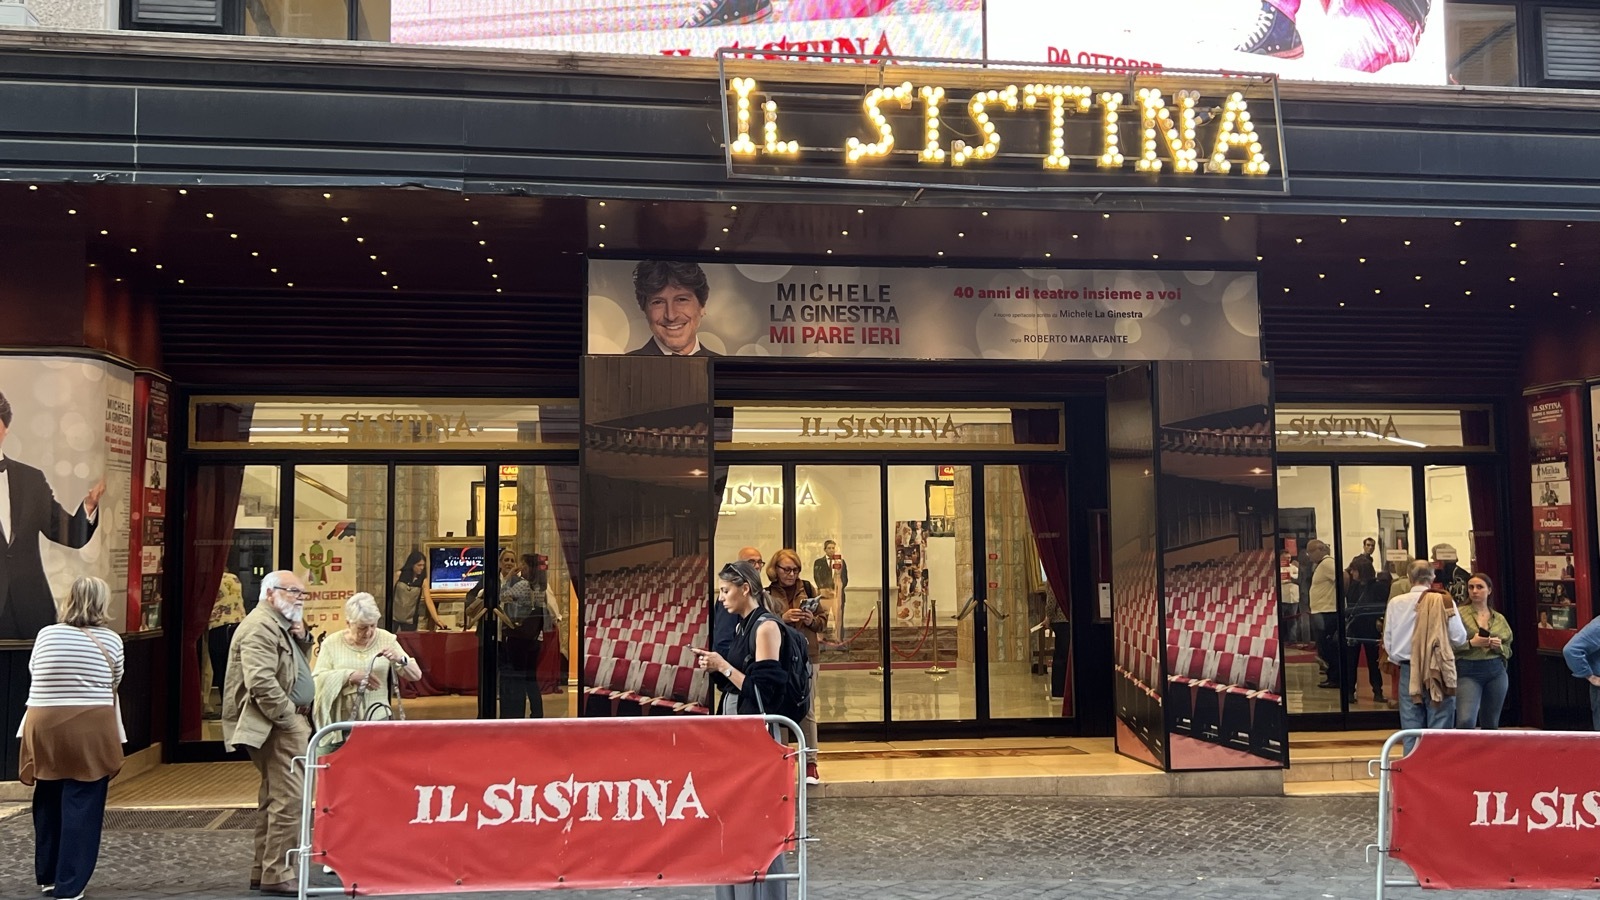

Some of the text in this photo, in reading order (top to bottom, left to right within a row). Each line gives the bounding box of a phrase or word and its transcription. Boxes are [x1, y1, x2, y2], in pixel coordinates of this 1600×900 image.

[1048, 46, 1071, 65] DA
[730, 77, 1271, 175] IL SISTINA
[777, 283, 891, 303] MICHELE
[954, 286, 1182, 300] 40 anni di teatro insieme a voi
[770, 304, 900, 324] LA GINESTRA
[1060, 309, 1093, 319] Michele
[1095, 309, 1105, 319] La
[1107, 309, 1143, 319] Ginestra
[770, 326, 900, 345] MI PARE IERI
[1024, 334, 1068, 343] ROBERTO
[1070, 335, 1129, 344] MARAFANTE
[105, 410, 112, 421] LA
[107, 398, 131, 415] MICHELE
[300, 410, 475, 440] IL SISTINA
[799, 412, 961, 441] IL SISTINA
[1285, 414, 1401, 442] SISTINA
[724, 482, 817, 506] ISTIA
[409, 772, 709, 829] IL SISTINA
[1470, 790, 1519, 826] IL
